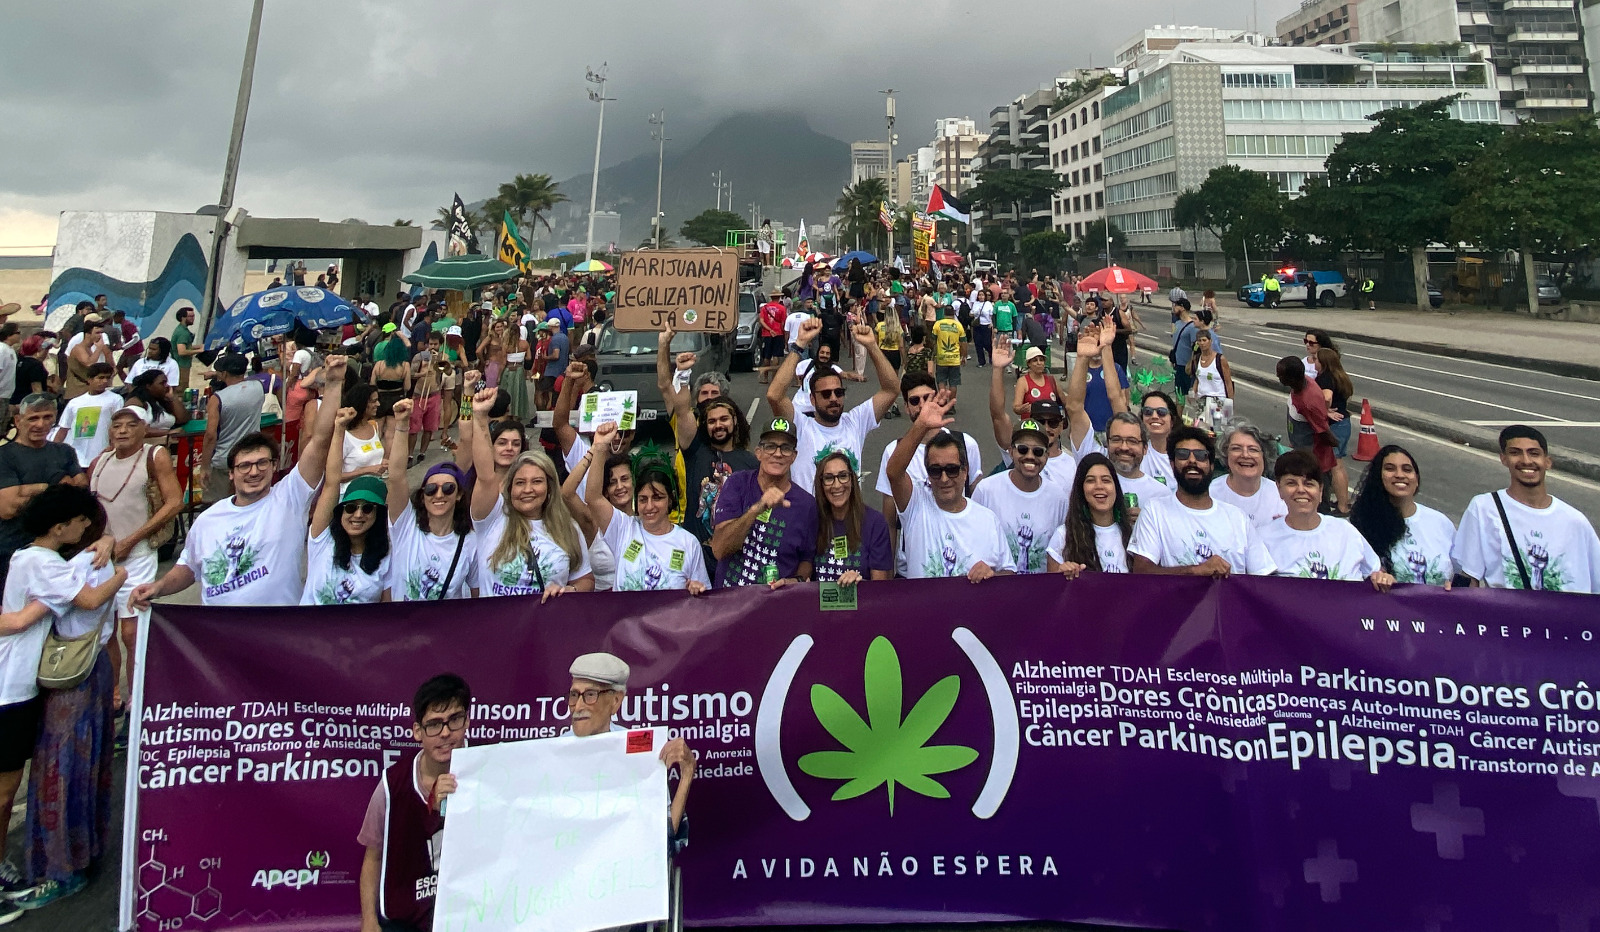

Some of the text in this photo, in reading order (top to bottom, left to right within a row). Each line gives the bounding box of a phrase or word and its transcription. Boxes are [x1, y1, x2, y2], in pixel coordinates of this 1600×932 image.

[621, 257, 723, 279] MARIJUANA
[616, 279, 733, 308] LEGALIZATION!
[650, 308, 728, 329] JÁ ER
[1012, 660, 1105, 679] Alzheimer
[1110, 665, 1161, 684] TDAH
[1167, 667, 1237, 686] Esclerose
[1240, 669, 1293, 687] Múltipla
[1300, 665, 1430, 698] Parkinson
[1434, 677, 1530, 708] Dores
[142, 701, 235, 722] Alzheimer
[241, 701, 288, 718] TDAH
[294, 701, 352, 716] Esclerose
[356, 702, 411, 720] Múltipla
[470, 697, 531, 720] inson
[611, 683, 753, 722] utismo
[1016, 681, 1096, 697] Fibromialgia
[1100, 681, 1171, 707] Dores
[1178, 686, 1277, 714] Crônicas
[1278, 692, 1347, 712] Doenças
[1352, 699, 1461, 721] Auto-Imunes
[1466, 710, 1539, 727] Glaucoma
[140, 722, 223, 746] Autismo
[225, 720, 294, 741] Dores
[301, 718, 392, 740] Crônicas
[1020, 698, 1112, 724] Epilepsia
[1111, 704, 1183, 719] Transtorno
[1186, 708, 1203, 721] de
[1206, 711, 1267, 728] Ansiedade
[1274, 709, 1312, 719] Glaucoma
[1341, 714, 1416, 733] Alzheimer
[1429, 723, 1464, 736] TDAH
[1469, 731, 1537, 750] Câncer
[168, 745, 230, 764] Epilepsia
[233, 738, 302, 753] Transtorno
[305, 737, 320, 749] de
[323, 738, 381, 750] Ansiedade
[705, 748, 752, 760] Anorexia
[1025, 722, 1113, 747] Câncer
[1119, 721, 1268, 761] Parkinson
[1268, 721, 1455, 774] Epilepsia
[1458, 755, 1559, 774] Transtorno
[1563, 758, 1586, 776] de
[138, 761, 232, 789] Câncer
[237, 751, 379, 782] Parkinson
[199, 858, 221, 869] OH
[733, 852, 1058, 879] A VIDA NÃO ESPERA
[159, 917, 182, 931] HO
